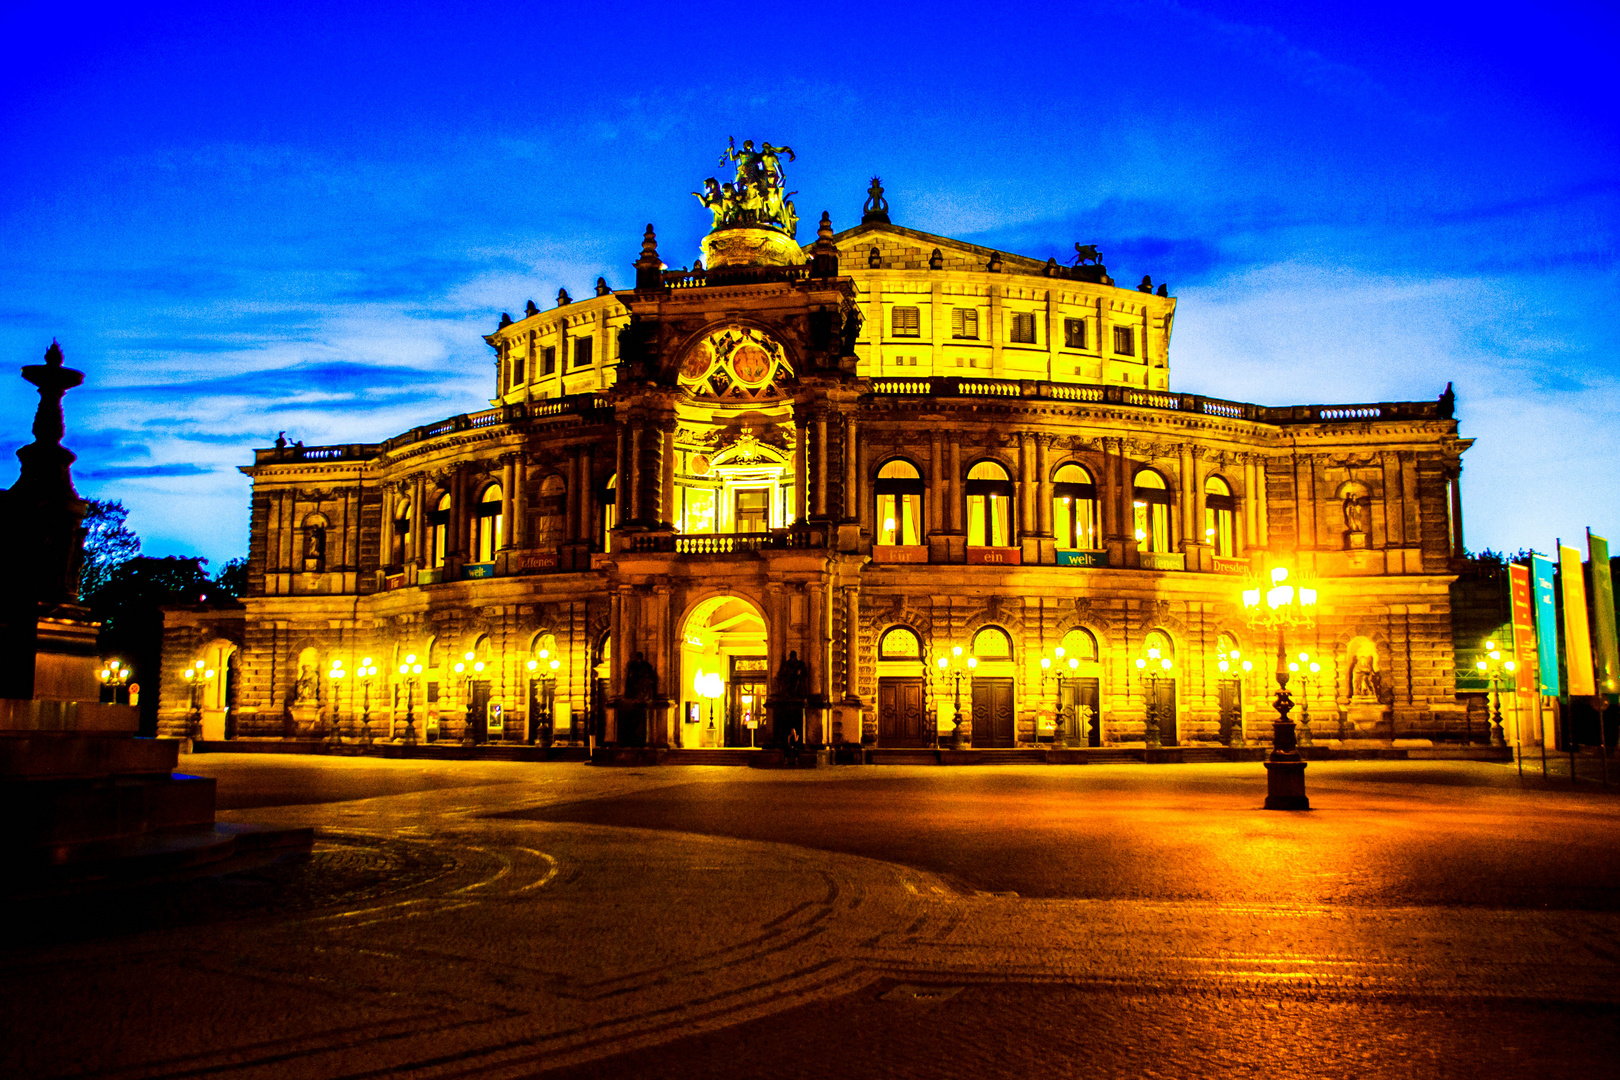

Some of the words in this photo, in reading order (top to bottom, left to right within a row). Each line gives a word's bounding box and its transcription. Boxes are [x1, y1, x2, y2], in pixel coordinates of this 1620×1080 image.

[984, 551, 1003, 562] ein
[1068, 553, 1096, 565] welt-
[1144, 556, 1181, 569] offenes
[1213, 561, 1249, 573] Dresden
